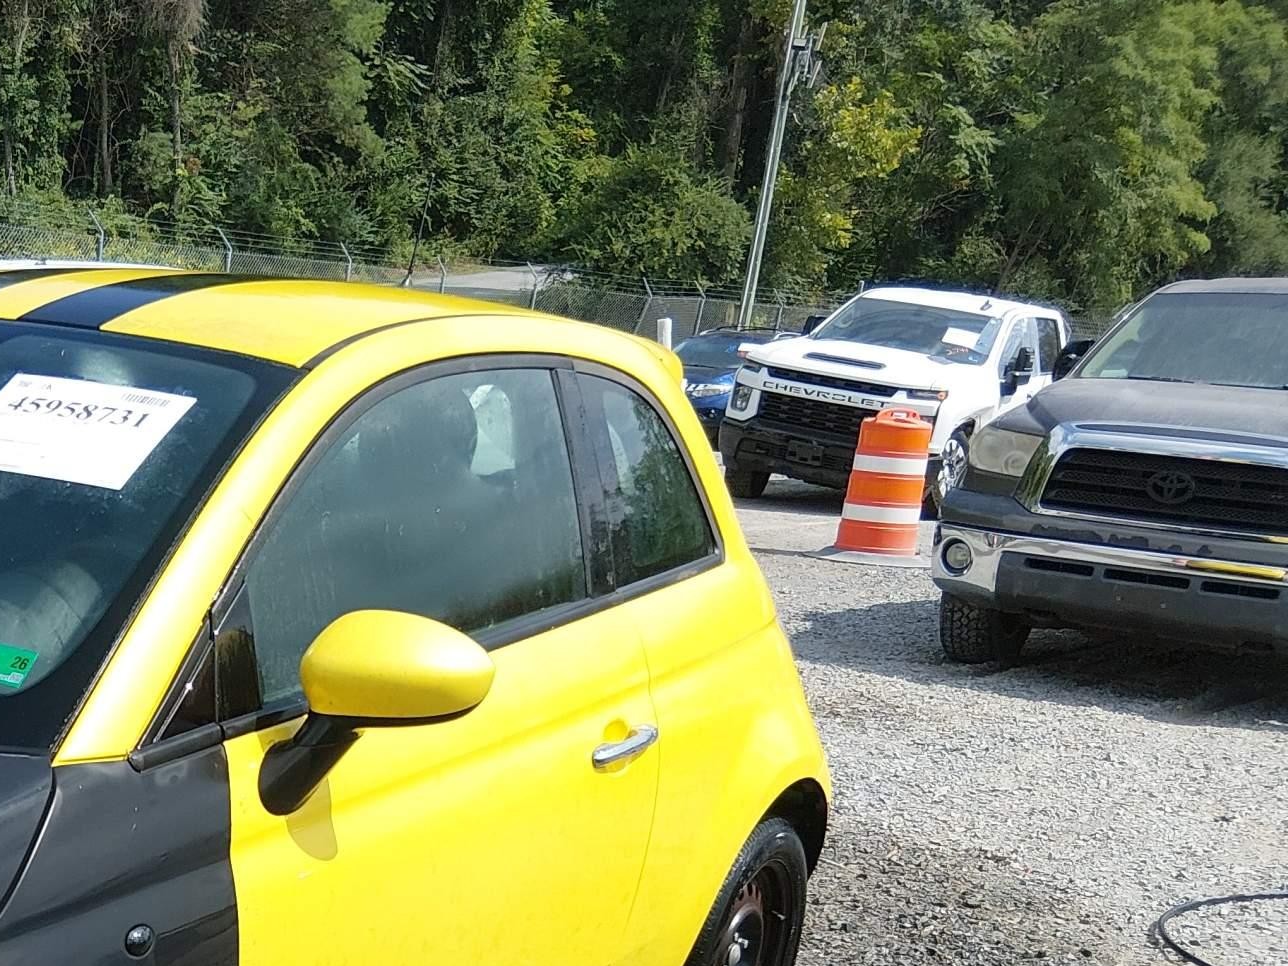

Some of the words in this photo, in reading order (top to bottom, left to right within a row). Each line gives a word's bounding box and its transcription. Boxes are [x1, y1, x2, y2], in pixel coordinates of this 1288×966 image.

[763, 381, 891, 409] CHEVROLET
[8, 396, 150, 428] 45958731
[10, 655, 30, 671] 26
